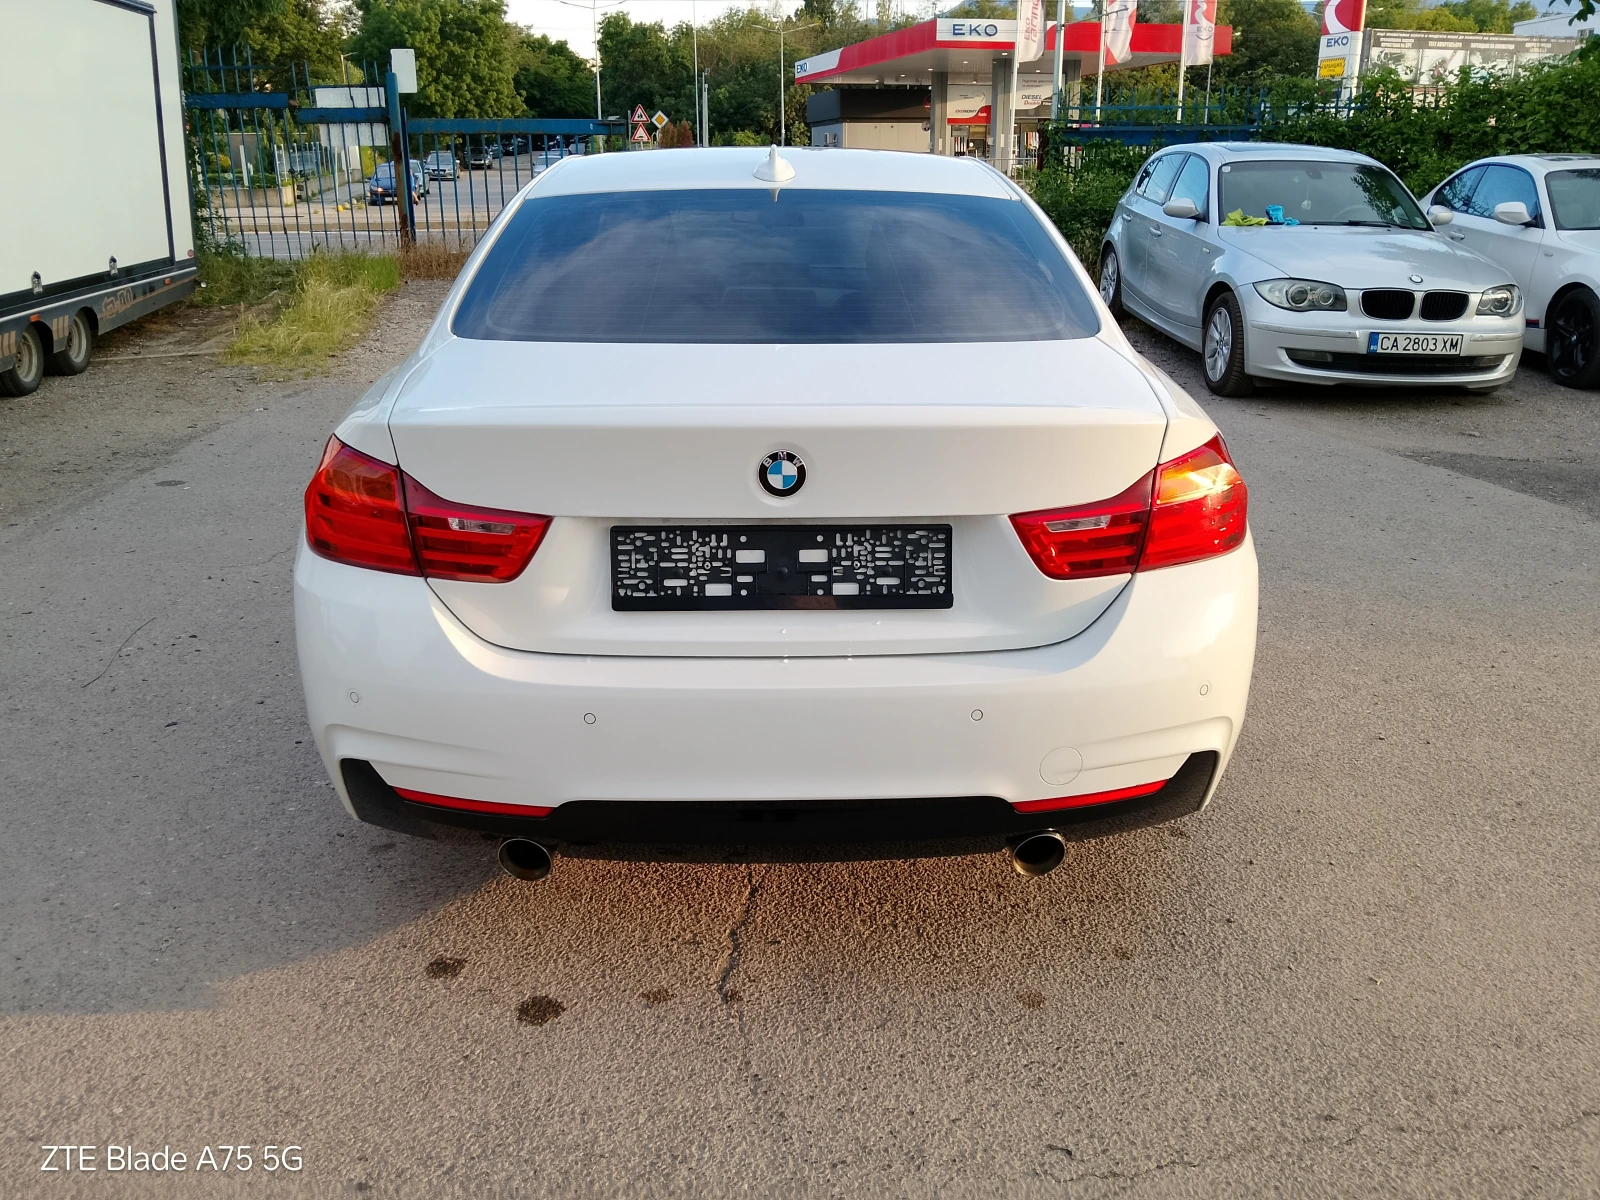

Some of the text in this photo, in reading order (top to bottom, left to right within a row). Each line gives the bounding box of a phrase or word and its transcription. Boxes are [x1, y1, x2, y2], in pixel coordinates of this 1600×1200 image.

[952, 24, 998, 37] EKO
[1326, 36, 1349, 47] EKO
[796, 62, 808, 74] EKO
[1380, 336, 1399, 351] CA
[1402, 337, 1438, 352] 2803
[1440, 338, 1459, 352] XM
[762, 451, 804, 467] BMW
